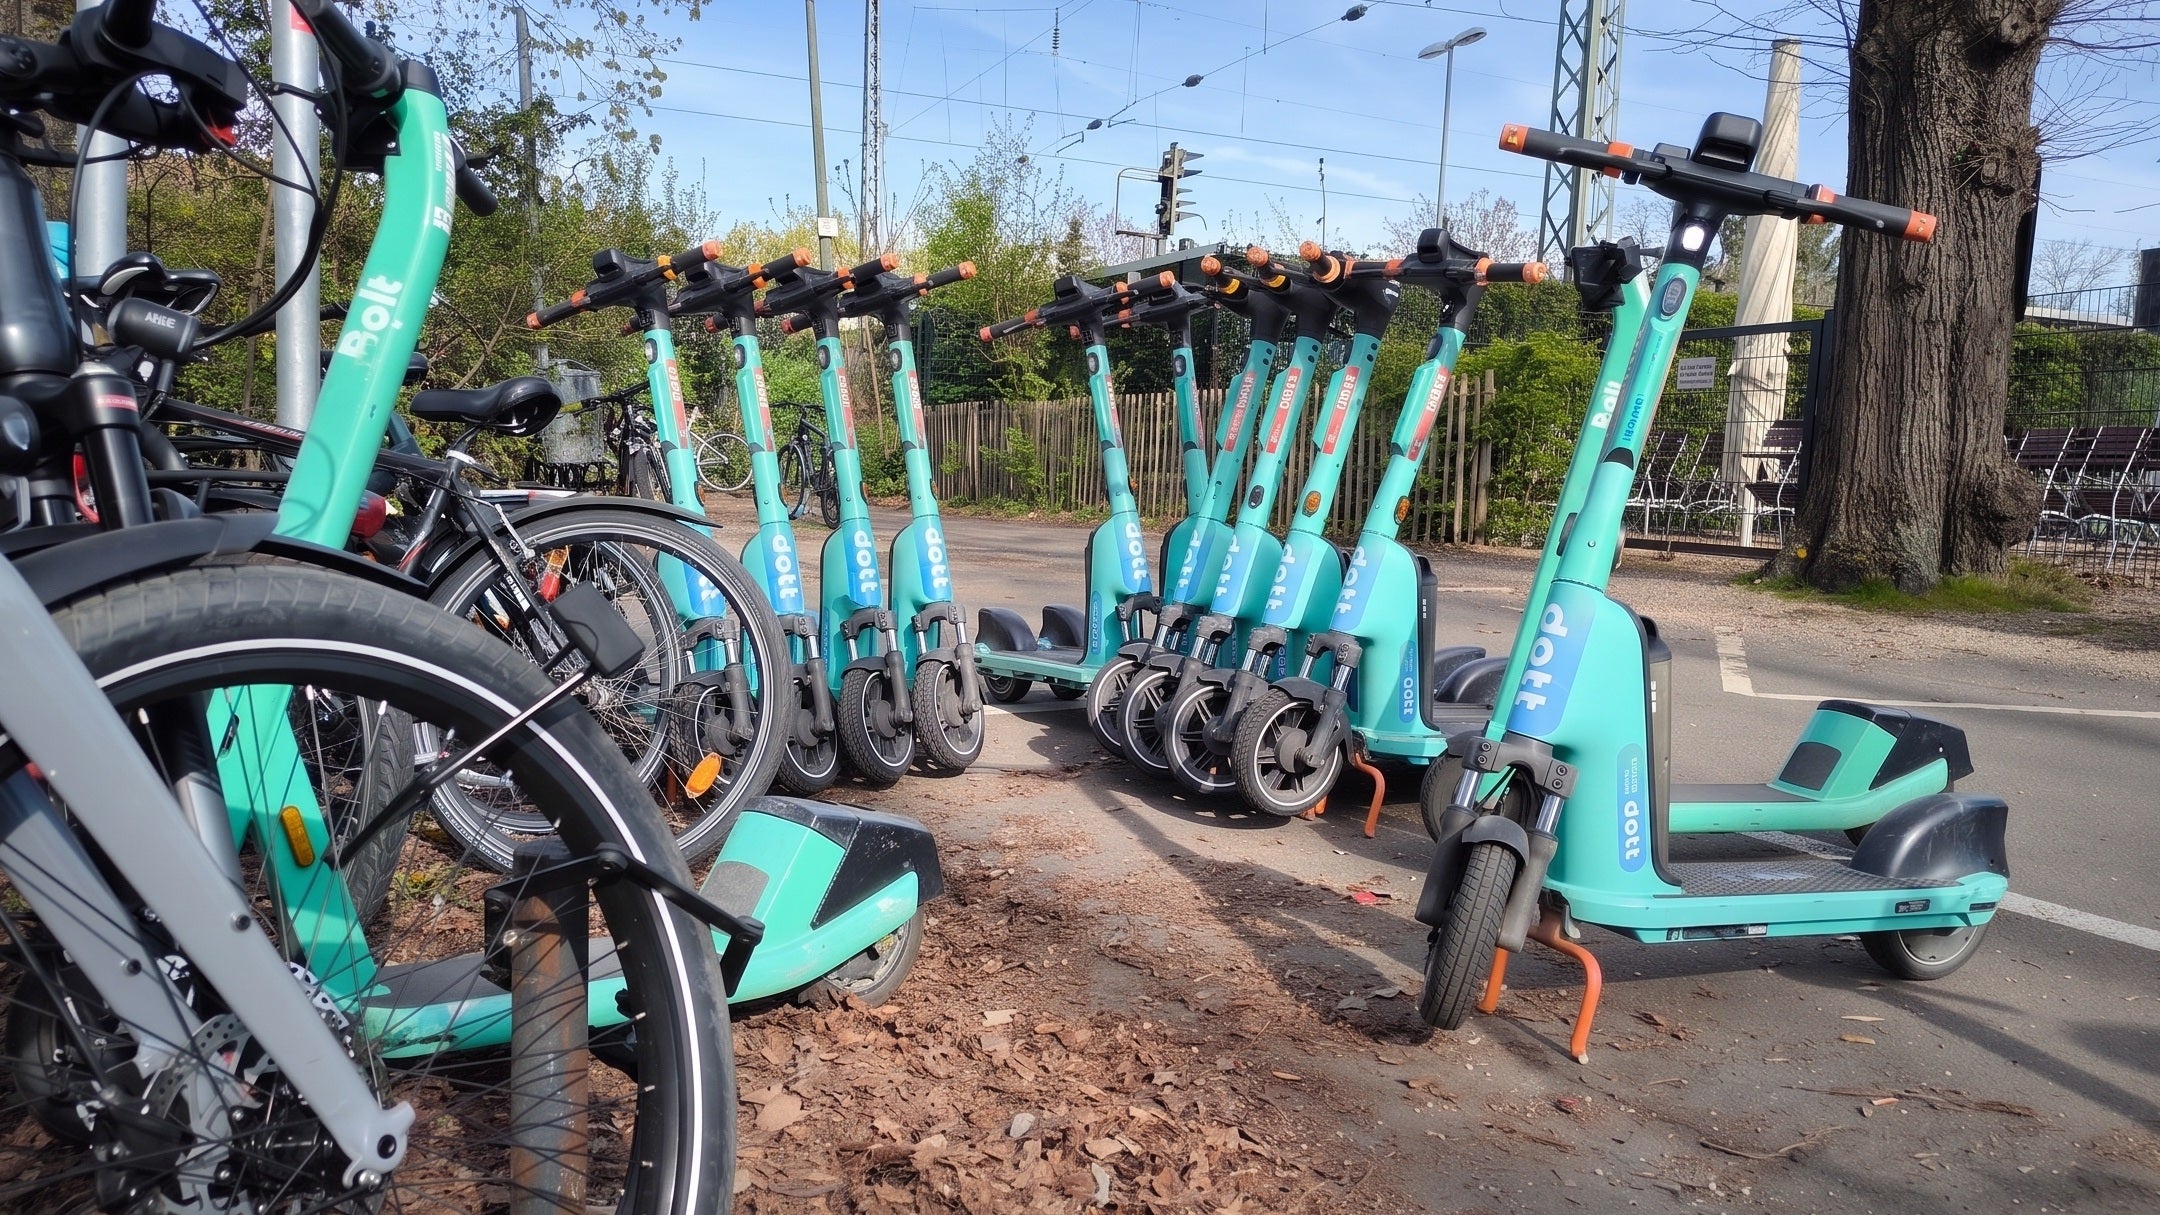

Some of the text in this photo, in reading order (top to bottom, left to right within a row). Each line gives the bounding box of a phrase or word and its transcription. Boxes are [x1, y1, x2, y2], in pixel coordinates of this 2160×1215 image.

[338, 274, 403, 358] Bolt
[773, 534, 798, 600] dott
[854, 530, 878, 594] dott
[925, 528, 949, 589] dott
[1125, 522, 1147, 580] dott
[1266, 544, 1296, 610] dott
[1336, 545, 1367, 614] dott
[1515, 602, 1568, 711] dott
[1624, 800, 1640, 860] dott
